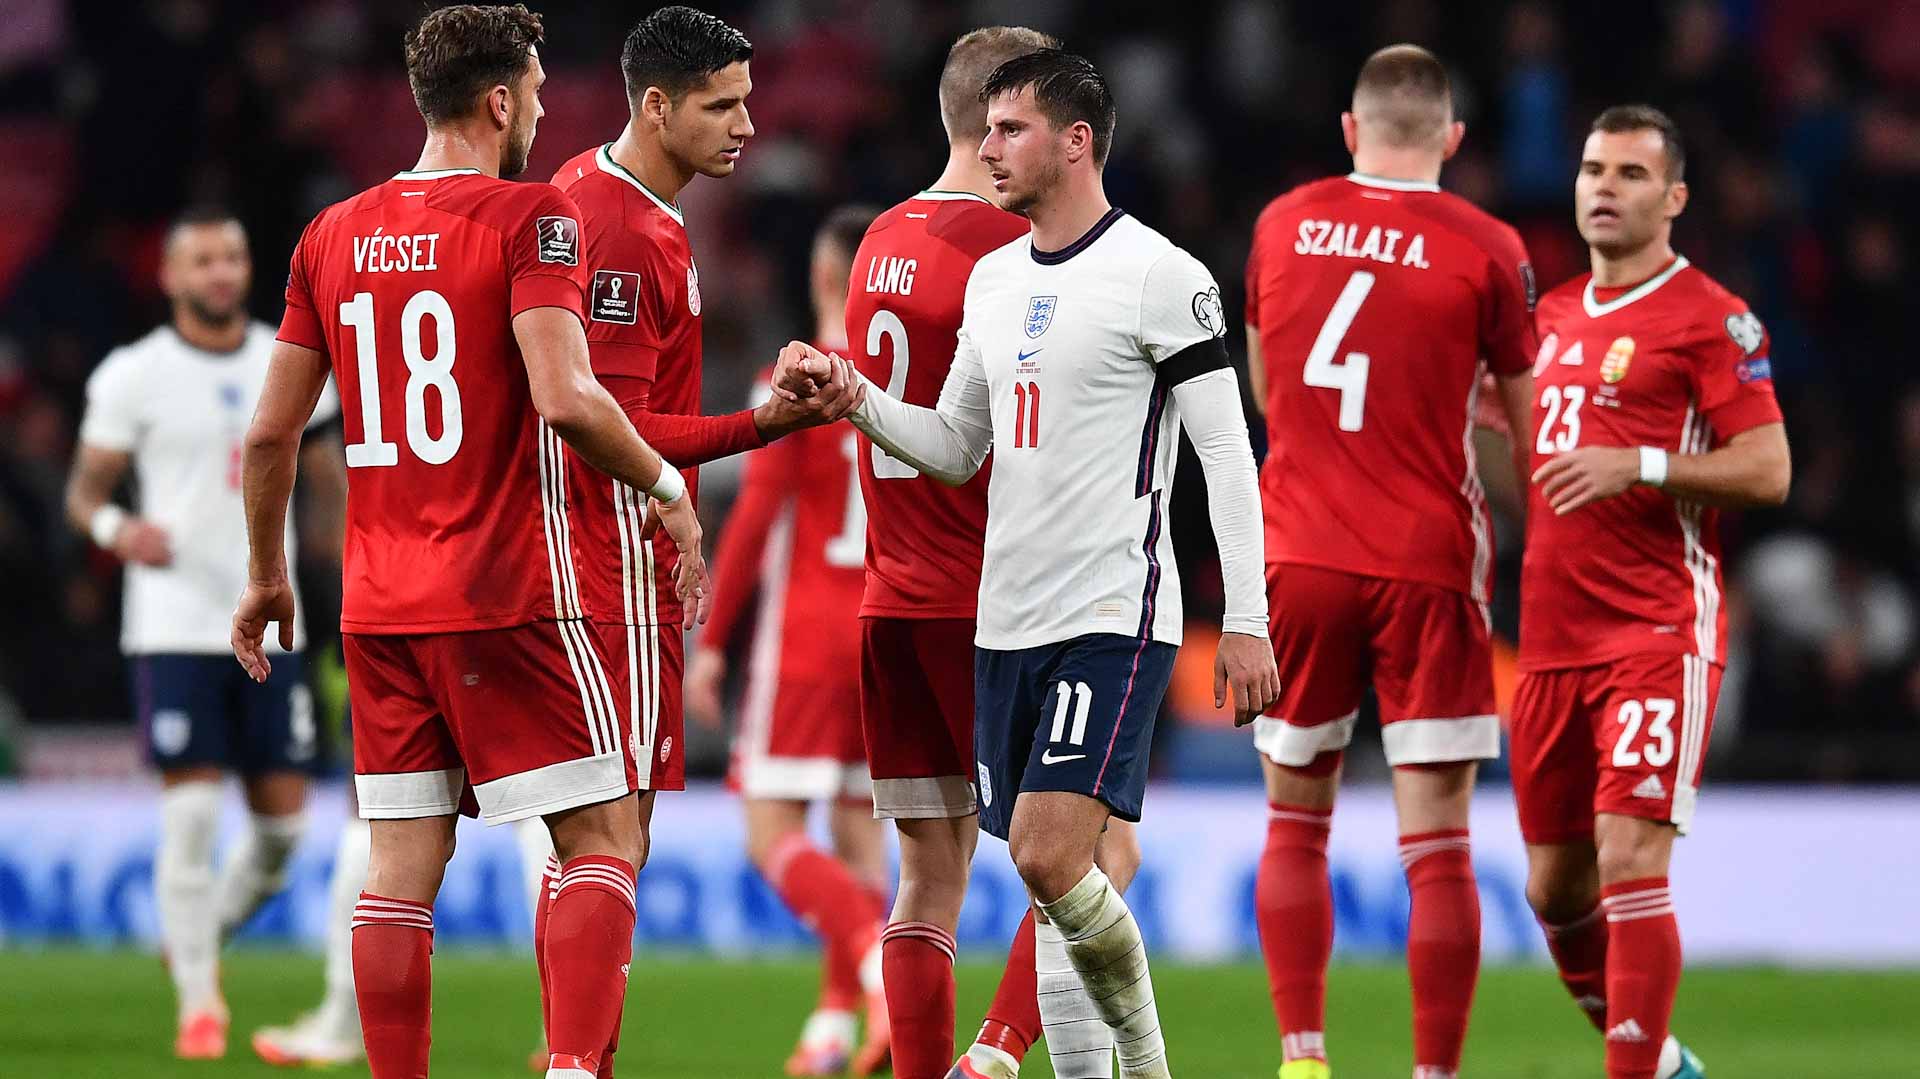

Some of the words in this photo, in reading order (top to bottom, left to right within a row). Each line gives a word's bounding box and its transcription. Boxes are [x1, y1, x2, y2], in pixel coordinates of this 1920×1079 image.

[352, 226, 440, 273] VÉCSEI
[865, 256, 918, 296] LANG
[1295, 219, 1403, 263] SZALAI
[1402, 233, 1430, 269] A.
[339, 290, 464, 467] 18
[1303, 270, 1376, 432] 4
[1014, 381, 1041, 448] 11
[1536, 384, 1586, 455] 23
[1047, 680, 1093, 746] 11
[1612, 697, 1677, 767] 23
